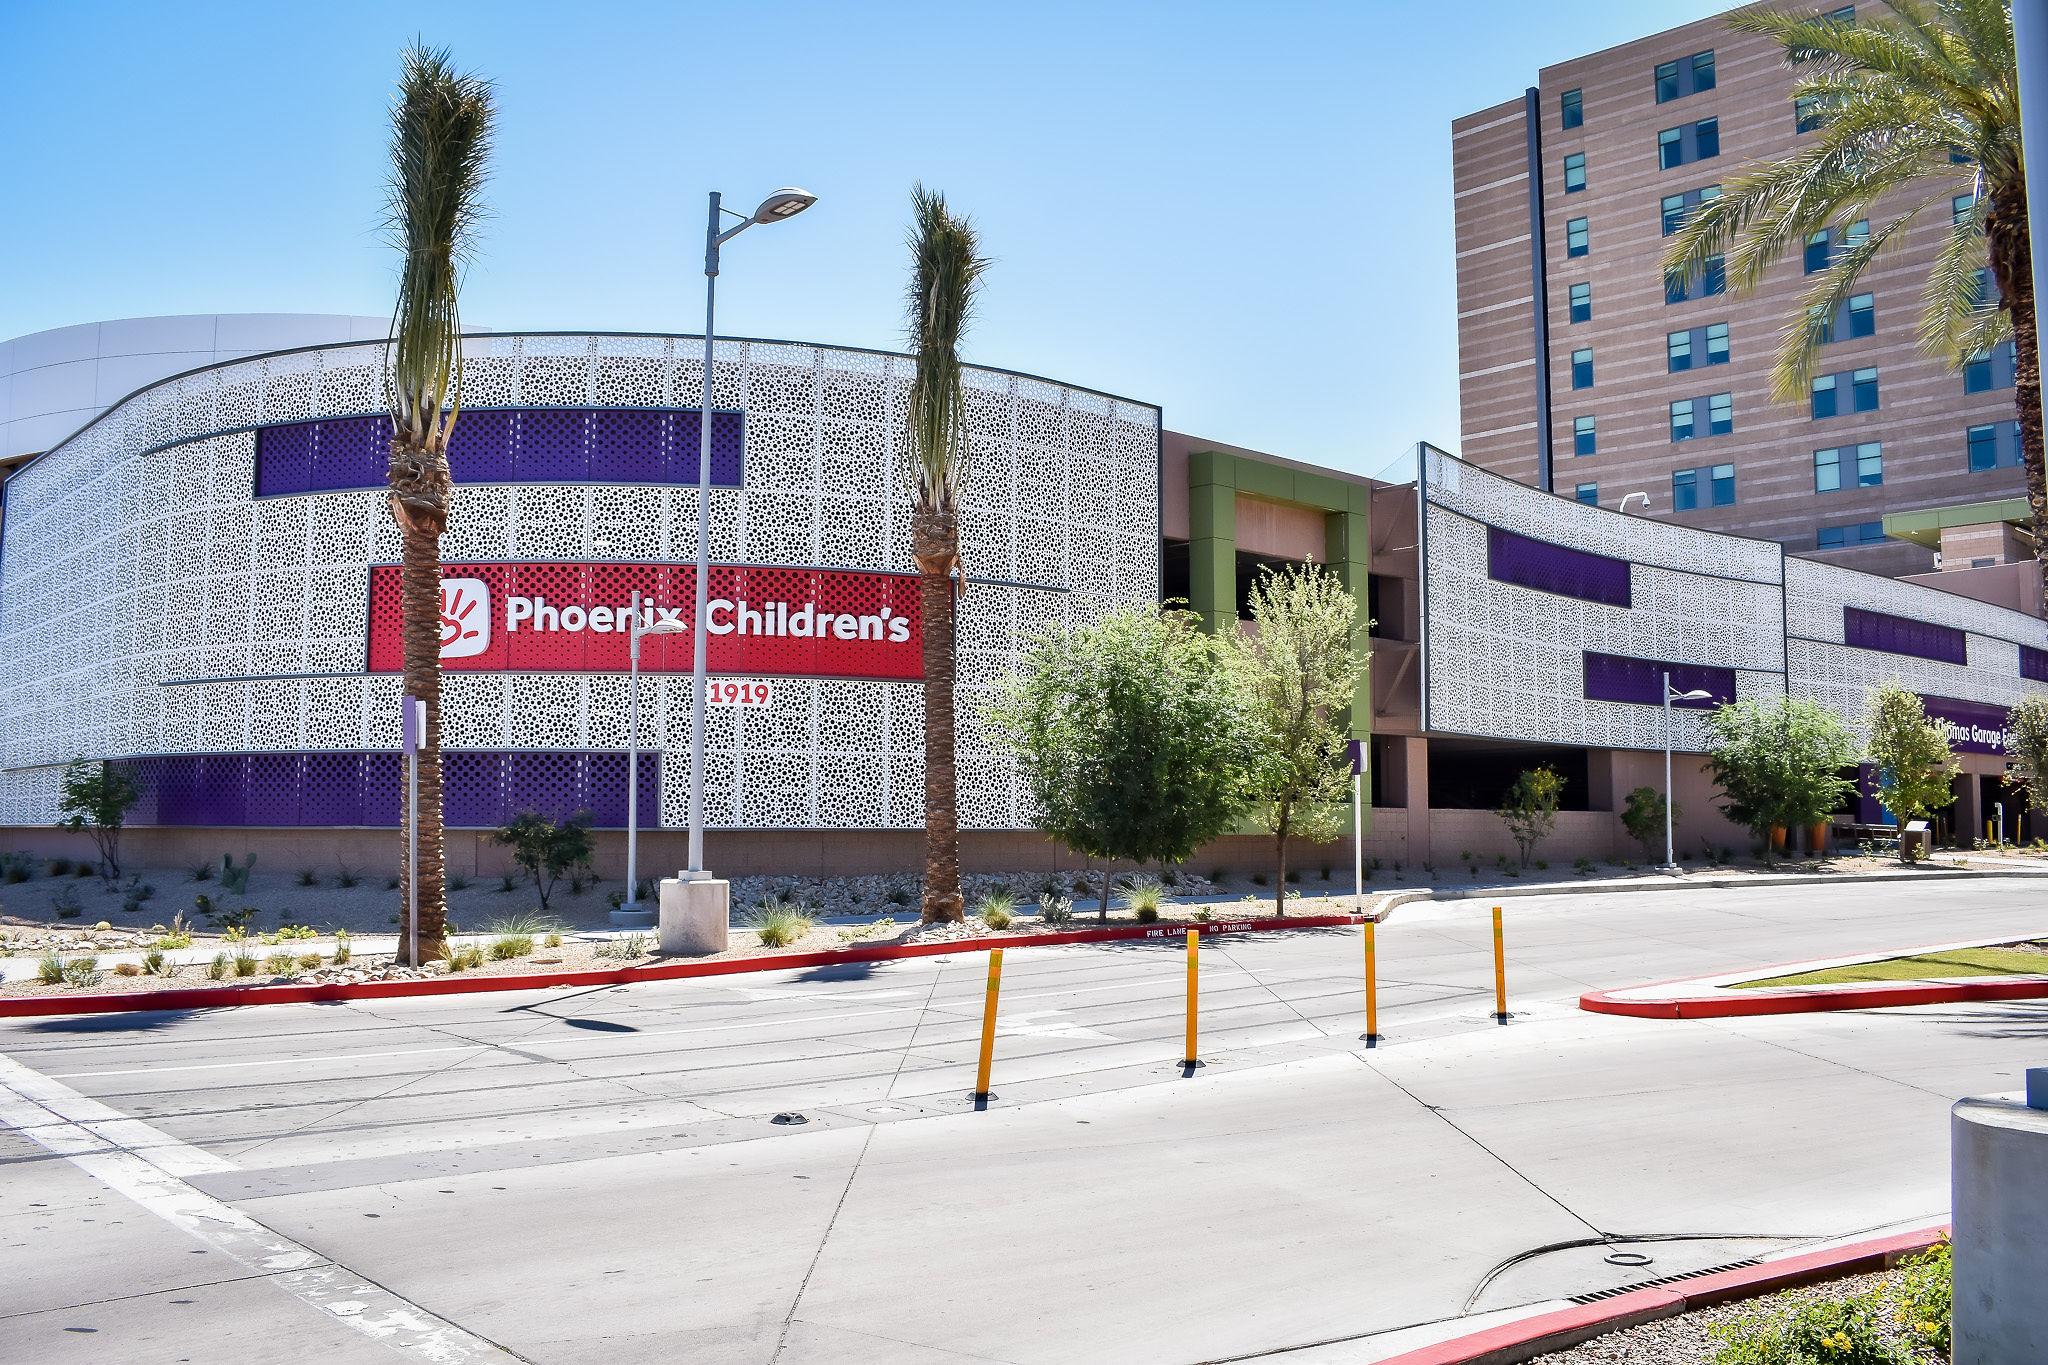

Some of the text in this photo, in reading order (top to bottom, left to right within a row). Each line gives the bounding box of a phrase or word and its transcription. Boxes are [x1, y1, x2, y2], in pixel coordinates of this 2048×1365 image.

[706, 599, 910, 642] Children's
[710, 683, 769, 705] 1919
[1971, 724, 2001, 750] Garage
[2002, 728, 2019, 746] Eas
[1146, 923, 1252, 938] FIRE LANE NO PARKING
